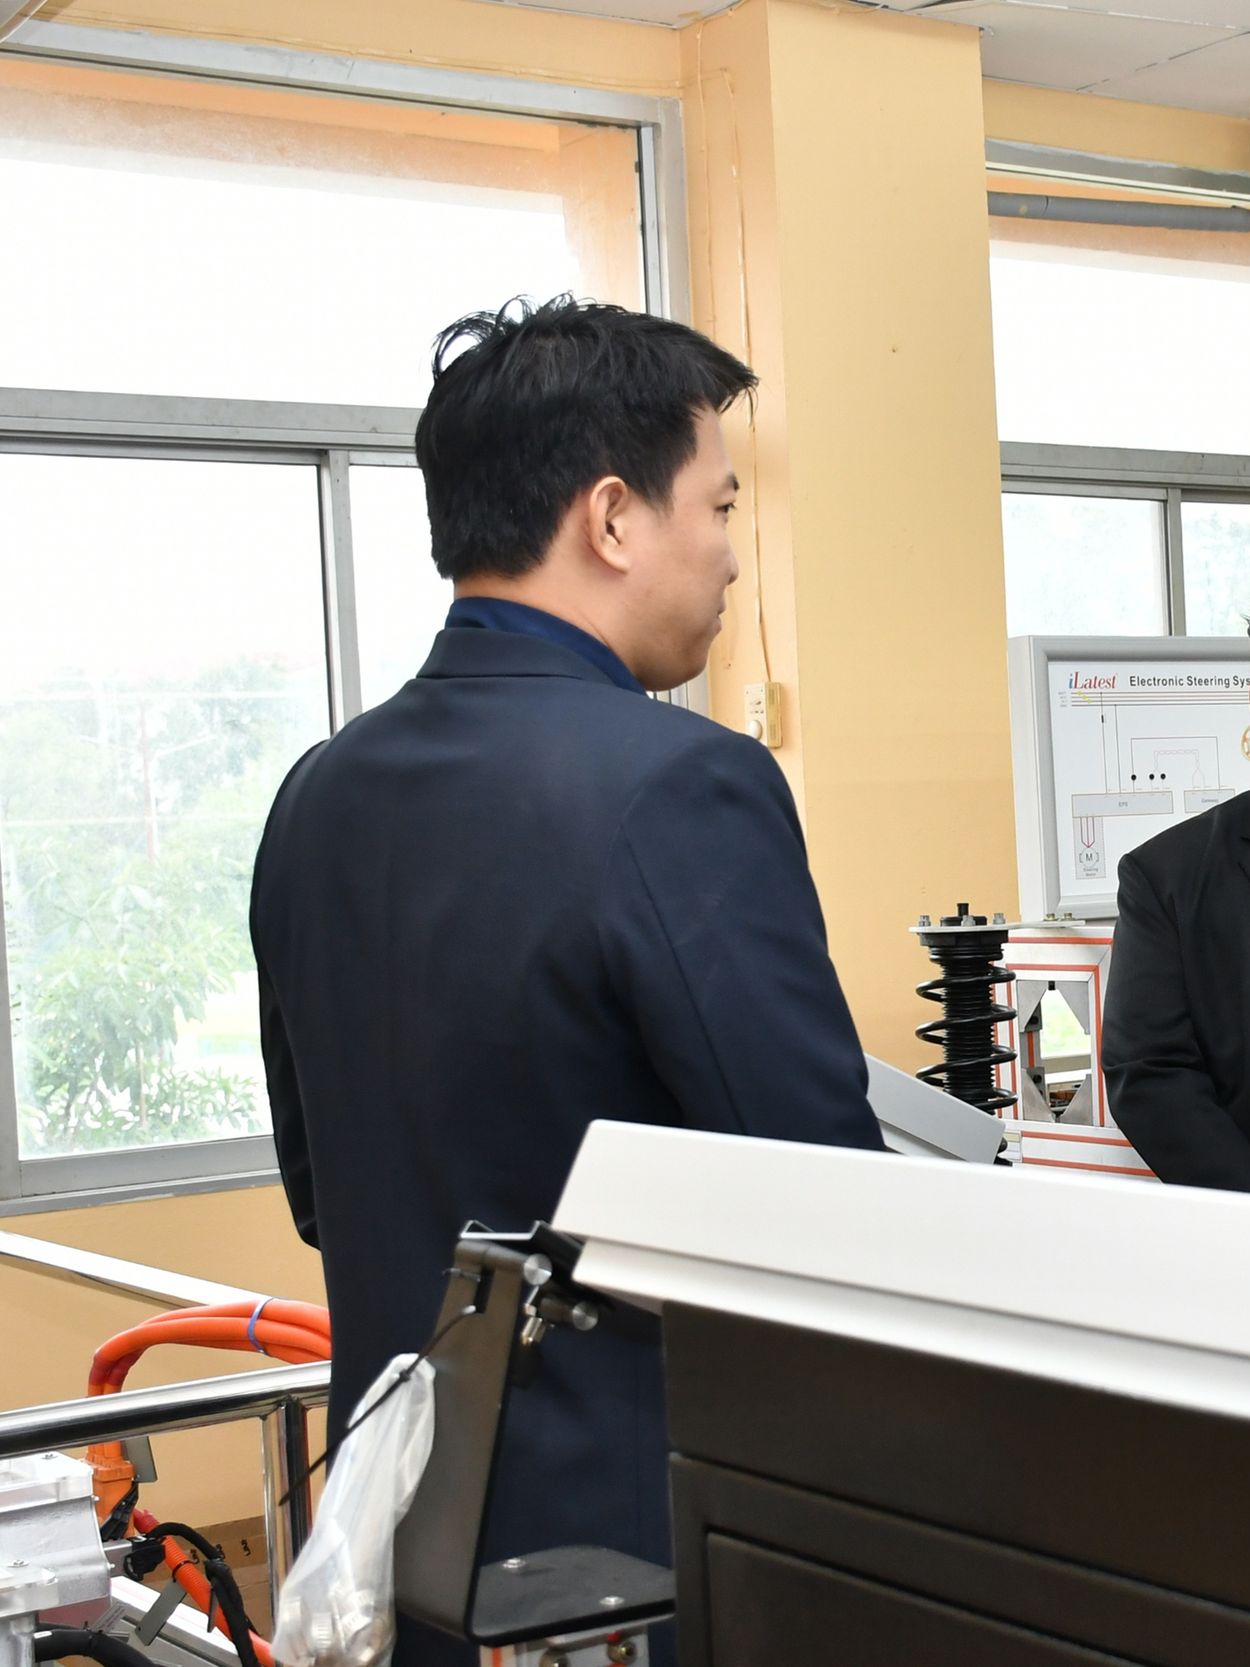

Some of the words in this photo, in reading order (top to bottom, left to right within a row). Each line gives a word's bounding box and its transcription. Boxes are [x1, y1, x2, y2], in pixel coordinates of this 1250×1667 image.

[1068, 671, 1116, 689] iLatest
[1129, 675, 1184, 687] Electronic
[1186, 675, 1230, 688] Steering
